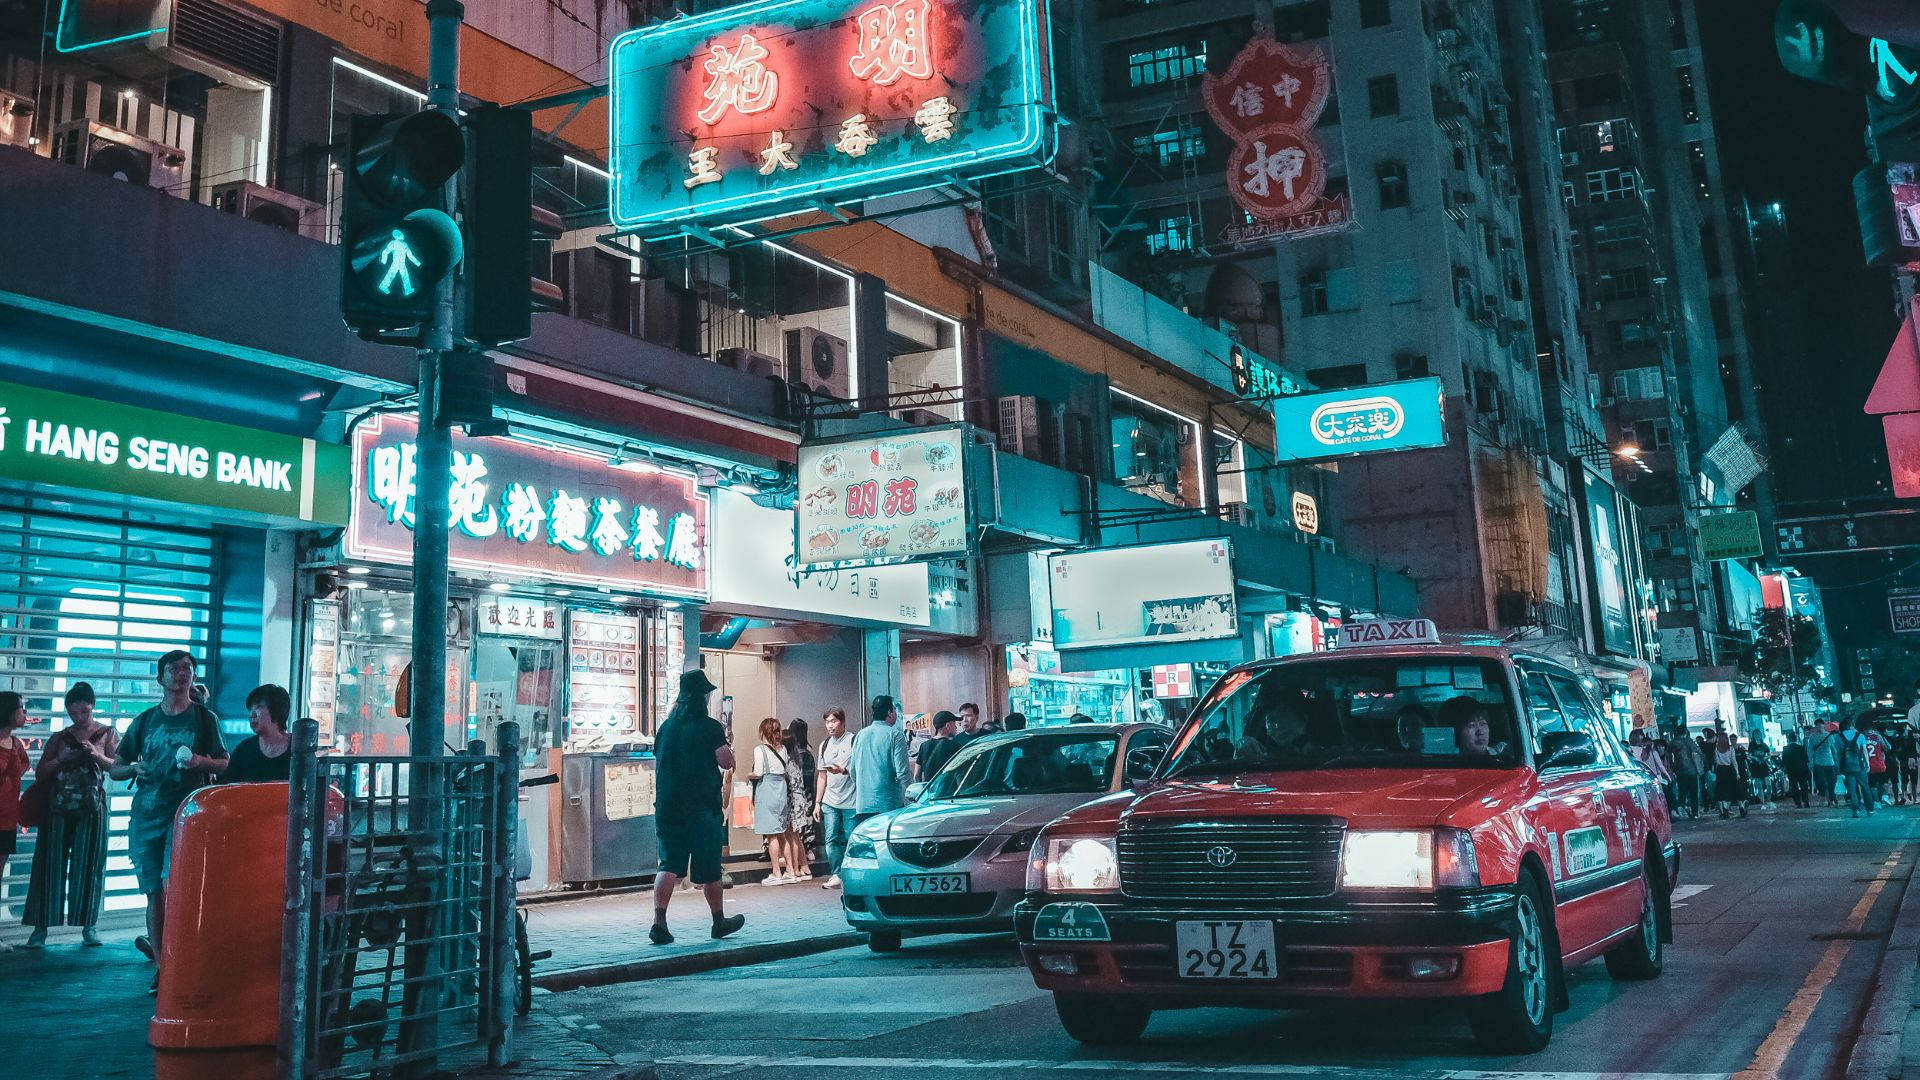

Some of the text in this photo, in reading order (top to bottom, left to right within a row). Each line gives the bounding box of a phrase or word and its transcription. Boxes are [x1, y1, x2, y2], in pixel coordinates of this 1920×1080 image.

[349, 4, 404, 42] coral
[1242, 140, 1307, 200] 押
[25, 417, 120, 466] HANG
[127, 436, 209, 479] SENG
[216, 450, 293, 492] BANK
[846, 476, 918, 519] 明苑
[488, 604, 555, 630] 歡迎光臨
[1344, 620, 1427, 643] TAXI
[1167, 672, 1177, 683] R
[893, 876, 964, 894] LK 7562
[1062, 909, 1076, 926] 4
[1048, 927, 1094, 939] SEATS
[1203, 921, 1247, 950] TZ
[1186, 949, 1271, 977] 2924
